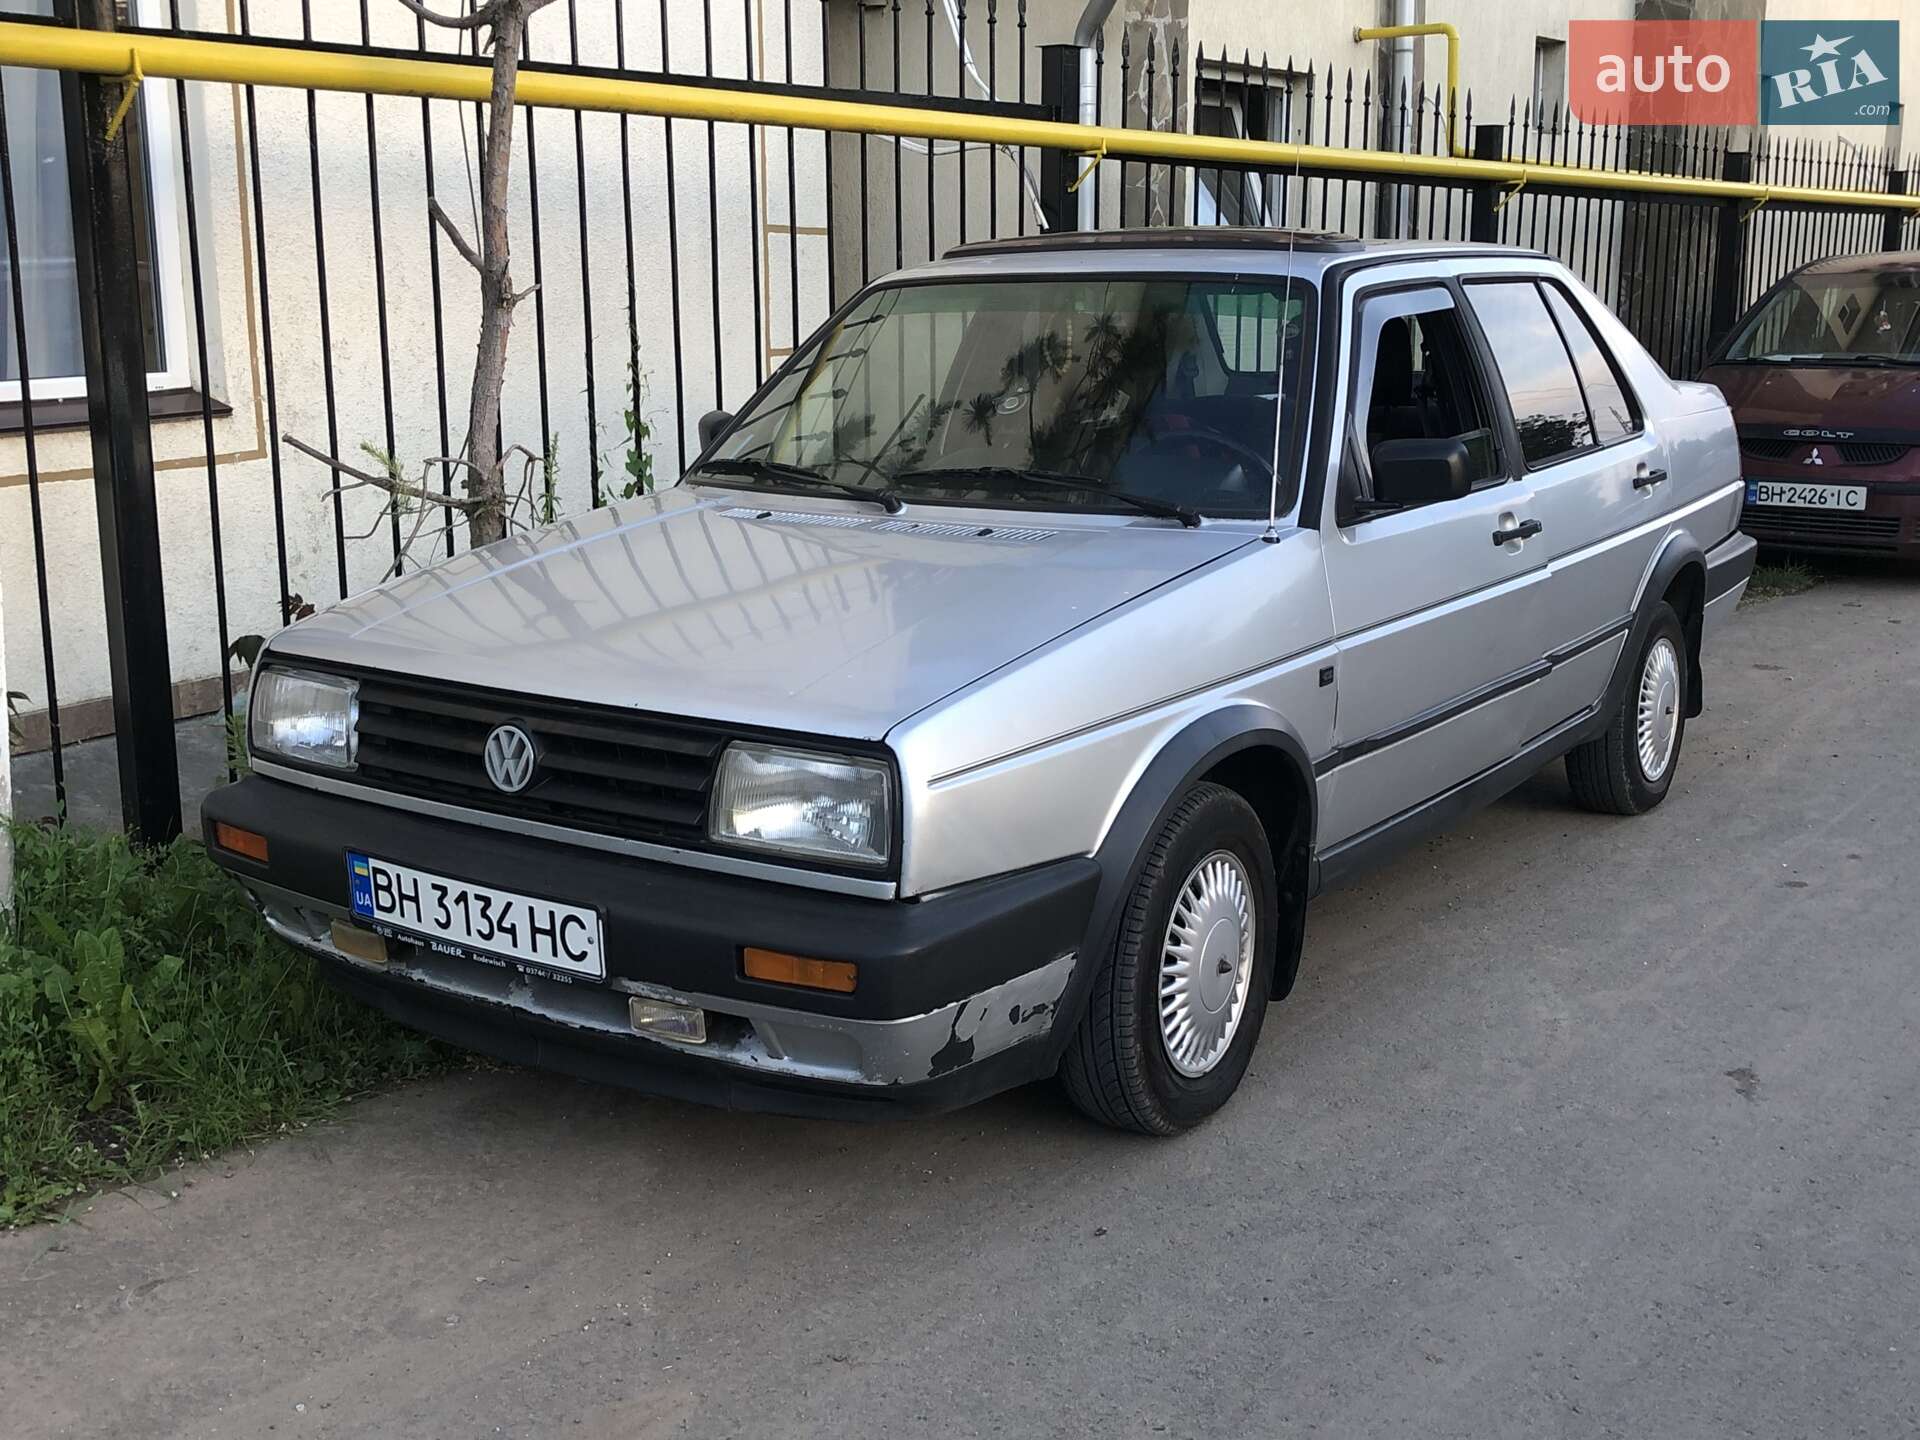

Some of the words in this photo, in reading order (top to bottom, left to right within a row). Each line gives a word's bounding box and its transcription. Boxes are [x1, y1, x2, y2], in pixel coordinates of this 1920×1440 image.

[1758, 485, 1784, 503] BH
[1786, 486, 1828, 505] 2426
[1836, 490, 1859, 507] IC
[355, 891, 373, 908] UA
[371, 866, 423, 924] BH
[430, 882, 519, 949] 3134
[528, 905, 588, 962] HC
[397, 933, 425, 947] Autohaus
[430, 941, 466, 959] BAUER
